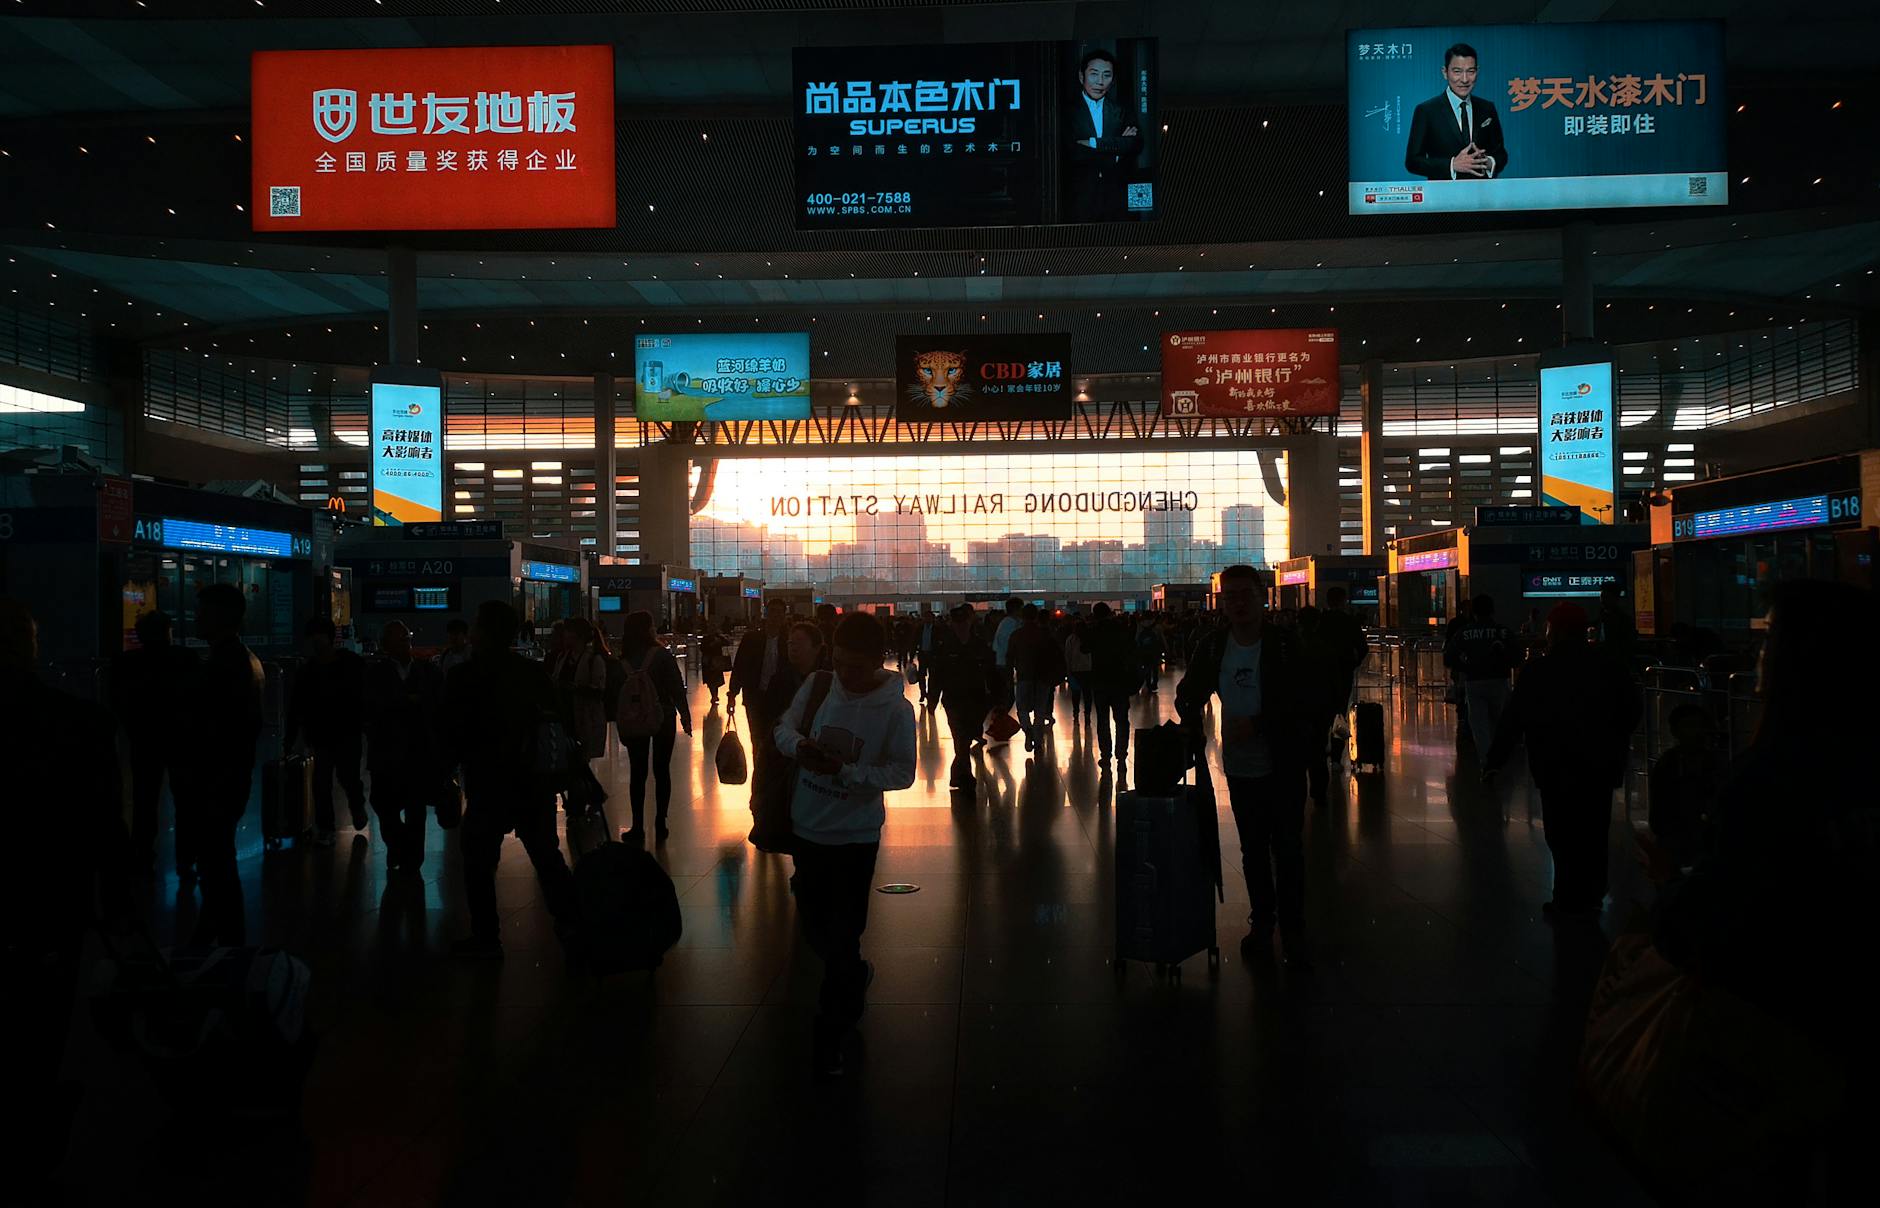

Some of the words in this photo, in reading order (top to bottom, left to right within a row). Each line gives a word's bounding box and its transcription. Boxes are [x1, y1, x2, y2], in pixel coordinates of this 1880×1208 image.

[1358, 43, 1413, 56] 梦天木门
[805, 78, 1020, 114] 尚品本色木门
[1508, 73, 1706, 112] 梦天水漆木门
[369, 90, 577, 135] 世友地板
[850, 117, 976, 136] SUPERUS
[1564, 113, 1655, 136] 即装即住
[807, 142, 1021, 156] 为空间而生的艺术木门
[315, 149, 577, 174] 全国质量奖获得企业
[807, 191, 911, 205] 400-021-7588
[807, 205, 911, 216] WWW.SPBS.COM.CN
[717, 358, 786, 373] 蓝河绵羊奶
[1197, 352, 1310, 364] 泸州市商业银行更名为
[980, 360, 1062, 379] CBD家居
[702, 378, 749, 393] 吸收好
[1550, 410, 1604, 426] 高铁媒体
[381, 429, 433, 443] 高铁媒体
[1551, 427, 1604, 442] 大影响者
[382, 445, 433, 459] 大影响者
[1831, 495, 1861, 519] B18
[134, 520, 161, 541] A18
[1674, 520, 1694, 537] B19
[293, 537, 311, 555] A19
[1585, 546, 1618, 560] B20
[422, 561, 454, 575] A20
[607, 578, 632, 590] A22
